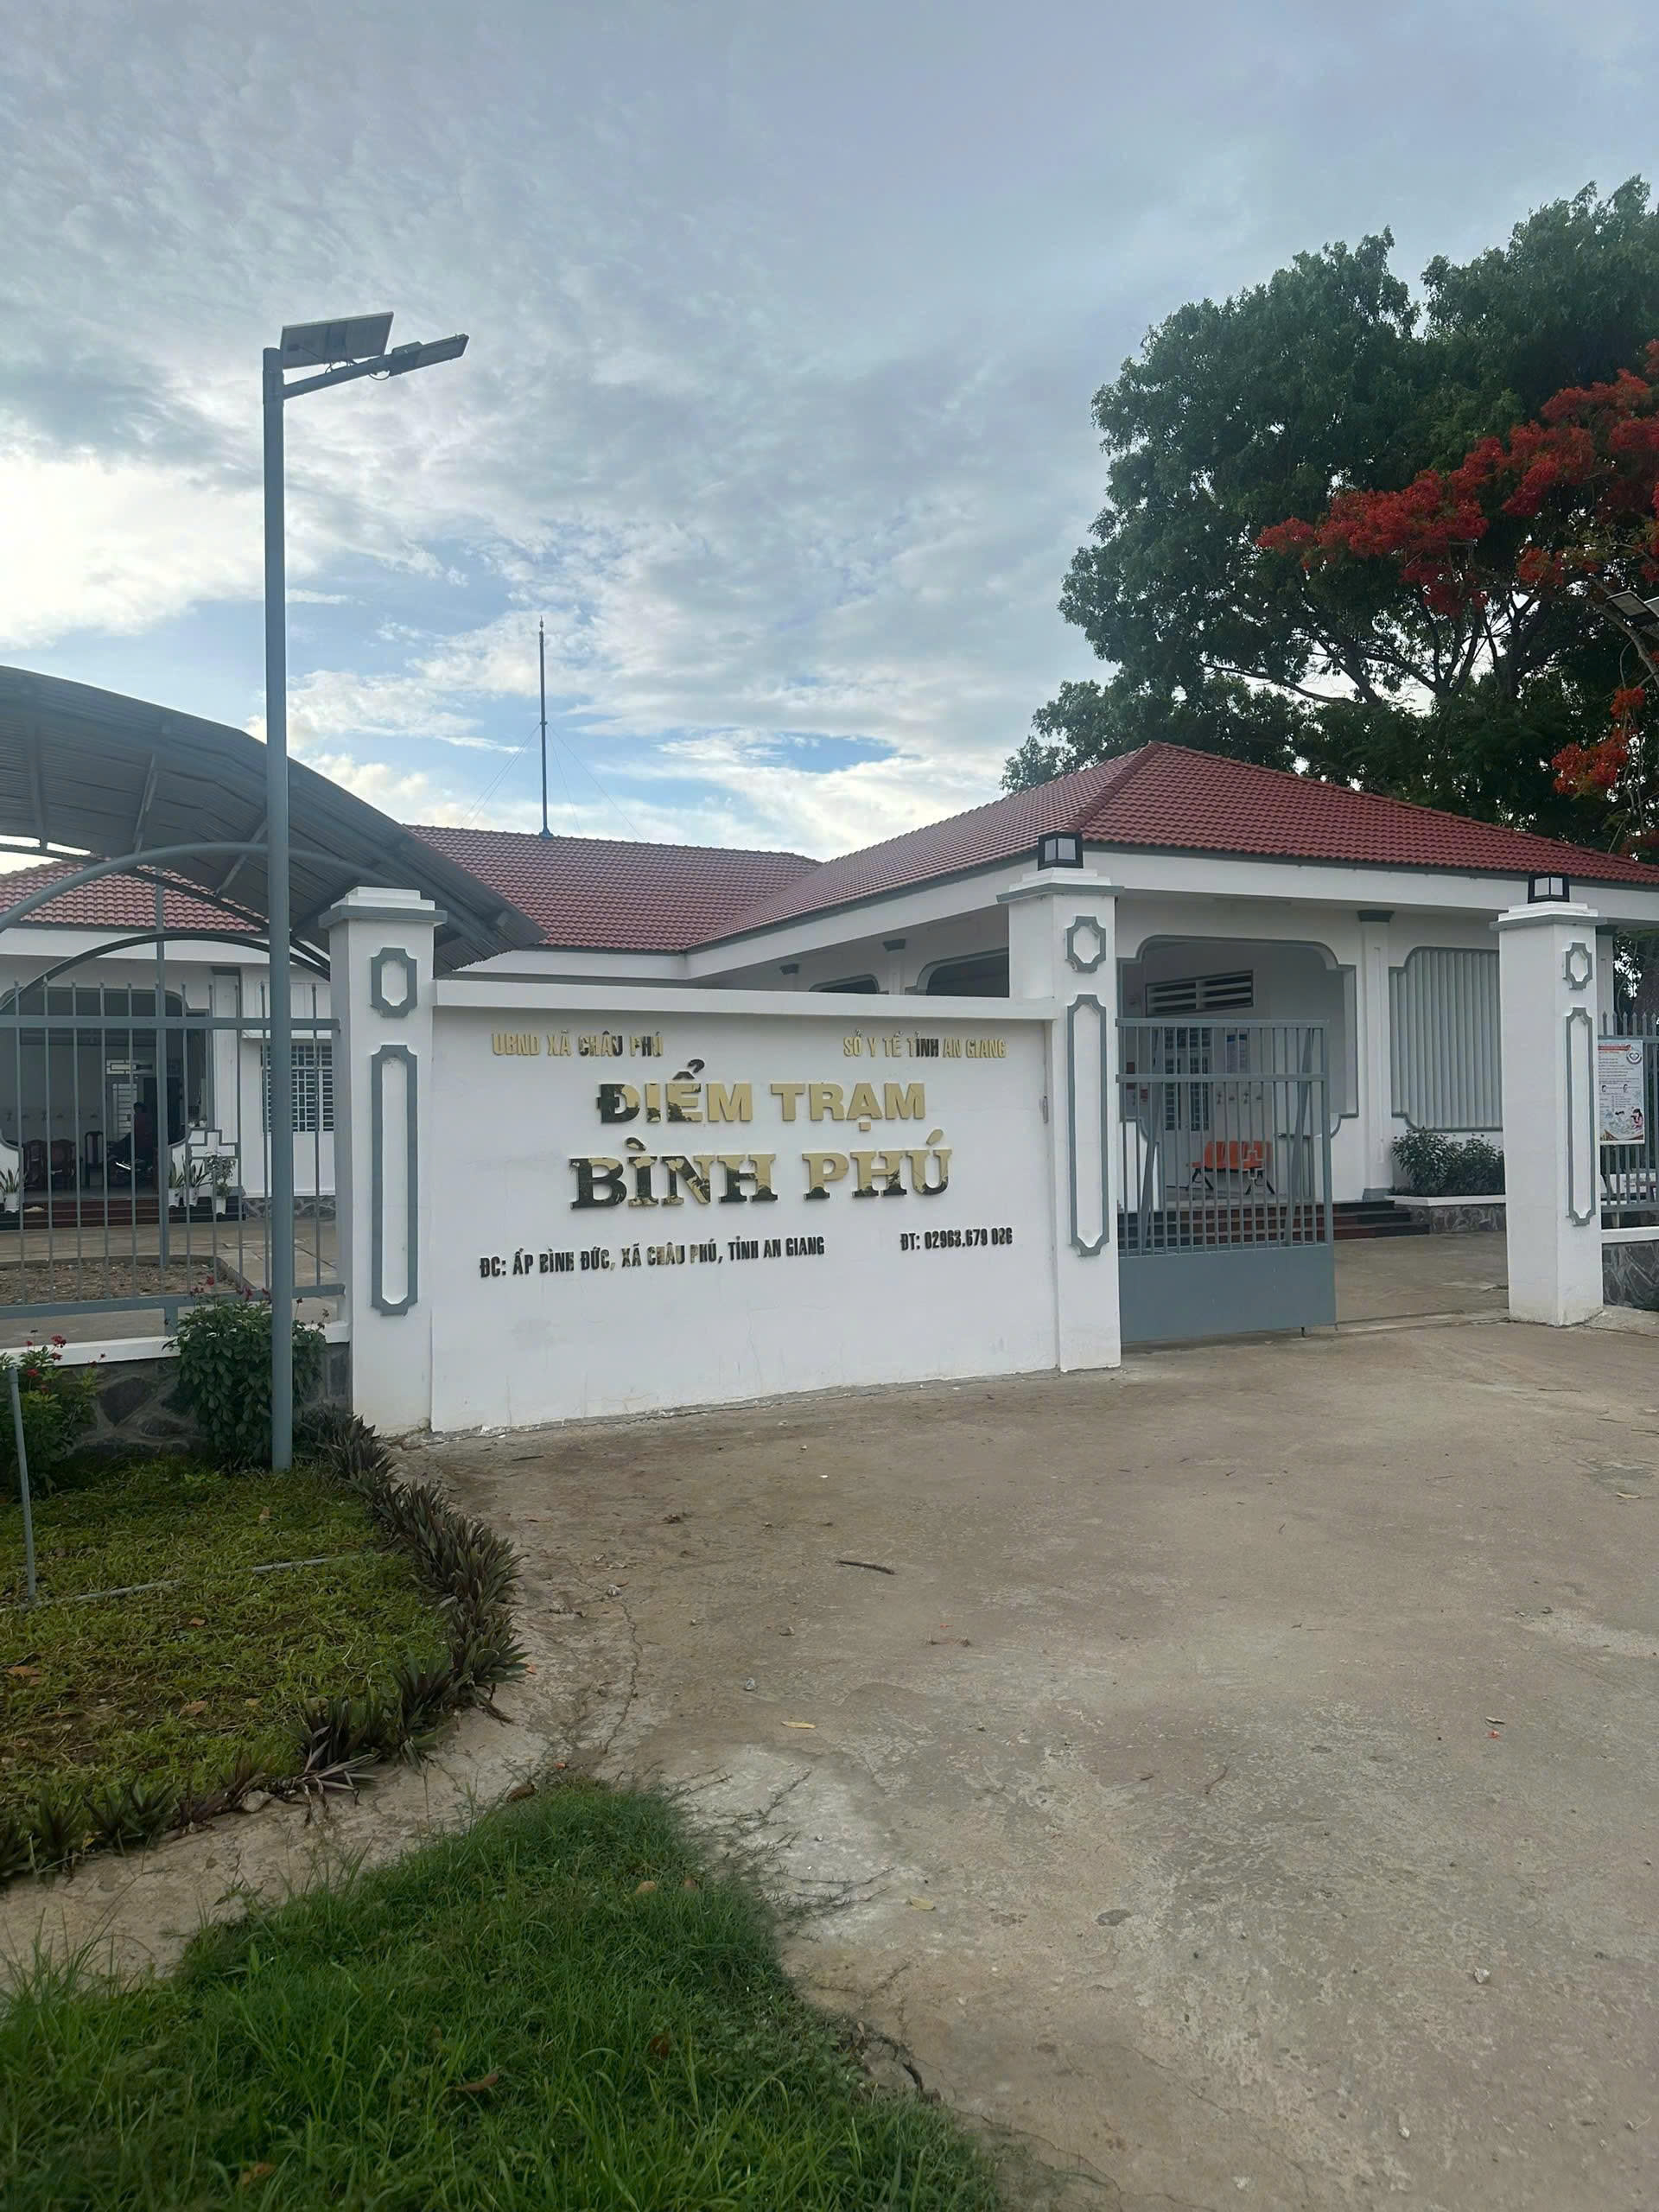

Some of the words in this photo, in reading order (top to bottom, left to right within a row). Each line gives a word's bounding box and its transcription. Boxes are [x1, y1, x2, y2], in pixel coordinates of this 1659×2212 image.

[493, 1033, 540, 1056] UBND
[548, 1030, 571, 1057] XÃ
[579, 1031, 623, 1057] CHÂU
[843, 1029, 862, 1057] SỞ
[867, 1038, 876, 1057] Y
[907, 1031, 939, 1058] TỈNH
[943, 1039, 961, 1058] AN
[966, 1039, 1007, 1058] GIANG
[596, 1059, 753, 1123] ĐIỂM
[771, 1083, 926, 1131] TRẠM
[567, 1137, 778, 1210] BÌNH
[802, 1128, 952, 1202] PHÚ
[480, 1256, 506, 1278] ĐC:
[512, 1248, 533, 1274] ẤP
[539, 1249, 575, 1273] BÌNH
[622, 1243, 642, 1268] XÃ
[647, 1242, 685, 1266] CHÂU
[728, 1236, 760, 1261] TỈNH
[764, 1239, 781, 1258] AN
[785, 1236, 824, 1256] GIANG
[899, 1233, 920, 1251] ĐT:
